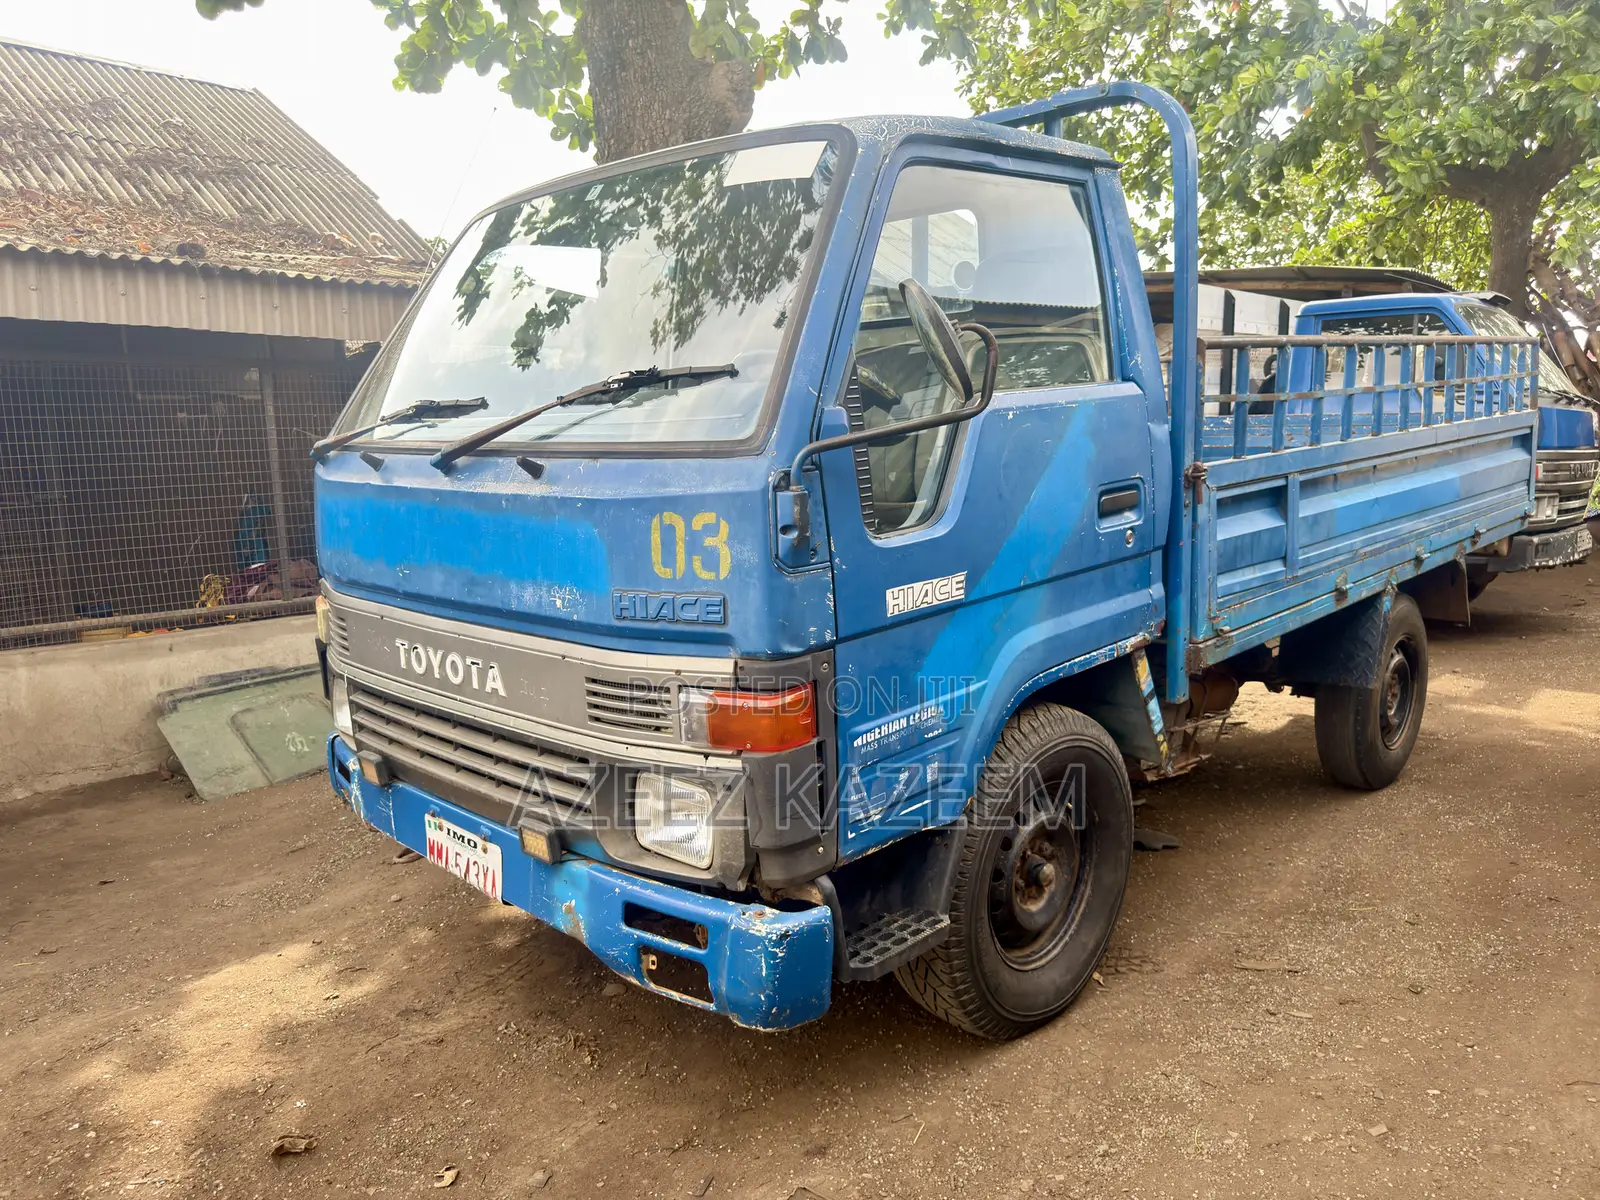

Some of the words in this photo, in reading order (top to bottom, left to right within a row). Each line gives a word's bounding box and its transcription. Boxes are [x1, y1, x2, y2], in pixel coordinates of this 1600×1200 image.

[651, 511, 731, 580] 03
[613, 592, 725, 624] HIACE
[888, 573, 965, 615] HIACE
[395, 638, 507, 698] TOYOTA
[853, 717, 907, 747] NIGERIAN
[860, 741, 879, 754] MASS
[446, 827, 478, 849] IMO
